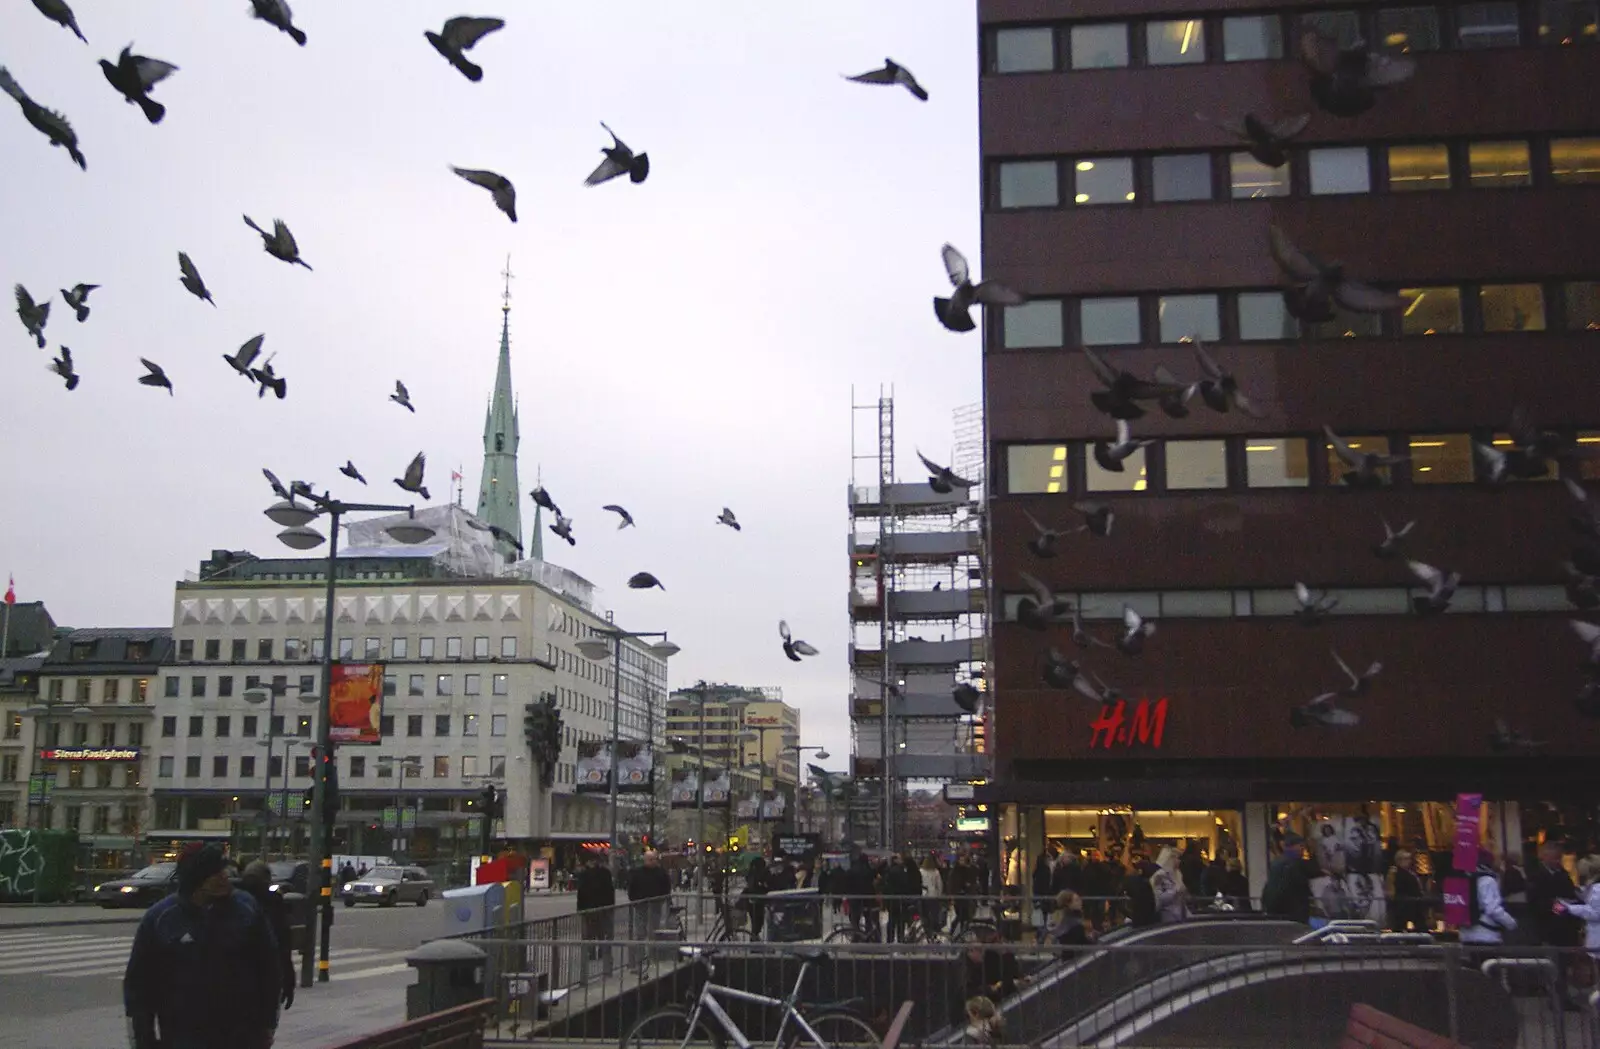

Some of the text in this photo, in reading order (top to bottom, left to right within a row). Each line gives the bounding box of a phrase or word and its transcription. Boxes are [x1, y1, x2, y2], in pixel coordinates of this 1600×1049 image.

[747, 716, 778, 724] Scandic
[55, 749, 137, 759] Stena Fastigheter
